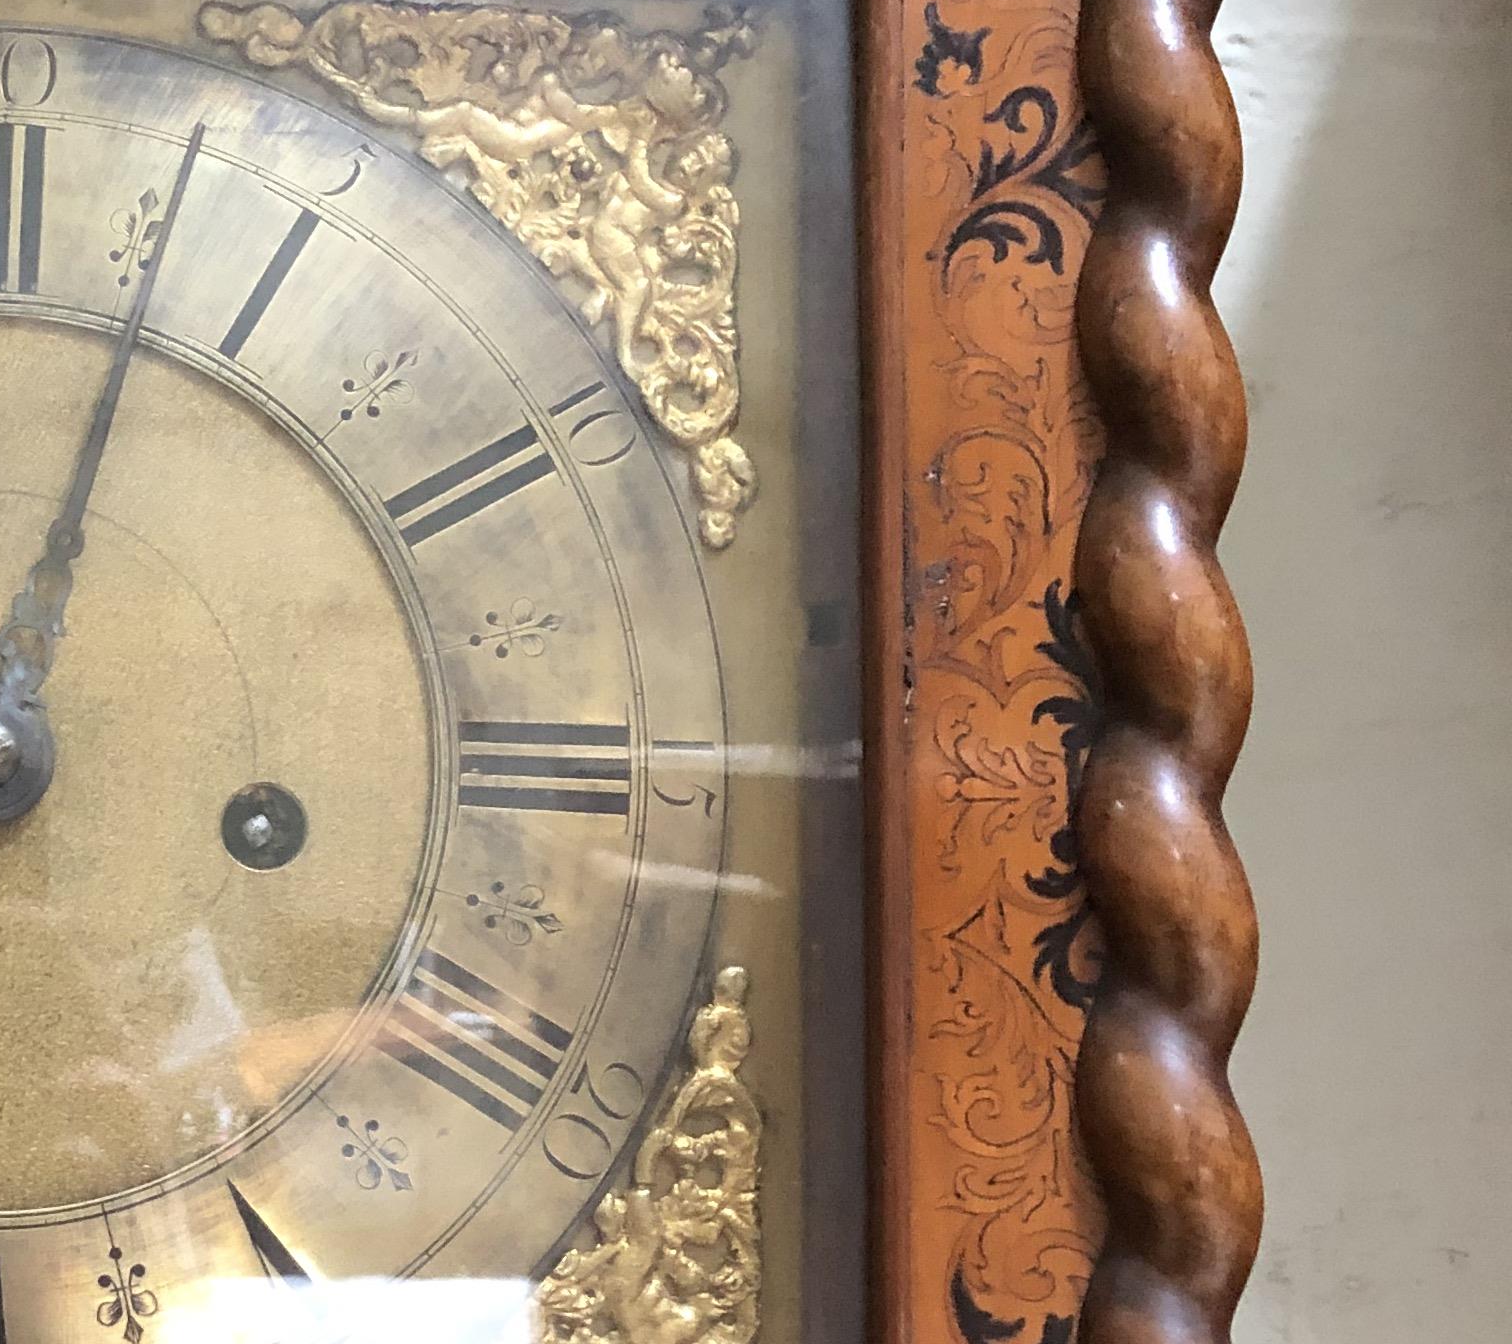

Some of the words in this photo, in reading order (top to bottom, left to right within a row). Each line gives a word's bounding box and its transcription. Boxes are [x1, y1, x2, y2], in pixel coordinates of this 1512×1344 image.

[317, 142, 378, 197] 5
[216, 196, 338, 369] I
[548, 380, 637, 466] 10
[376, 414, 562, 558] II
[456, 708, 631, 828] III
[652, 740, 718, 819] 15
[373, 928, 583, 1141] IIII
[542, 1060, 644, 1180] 20
